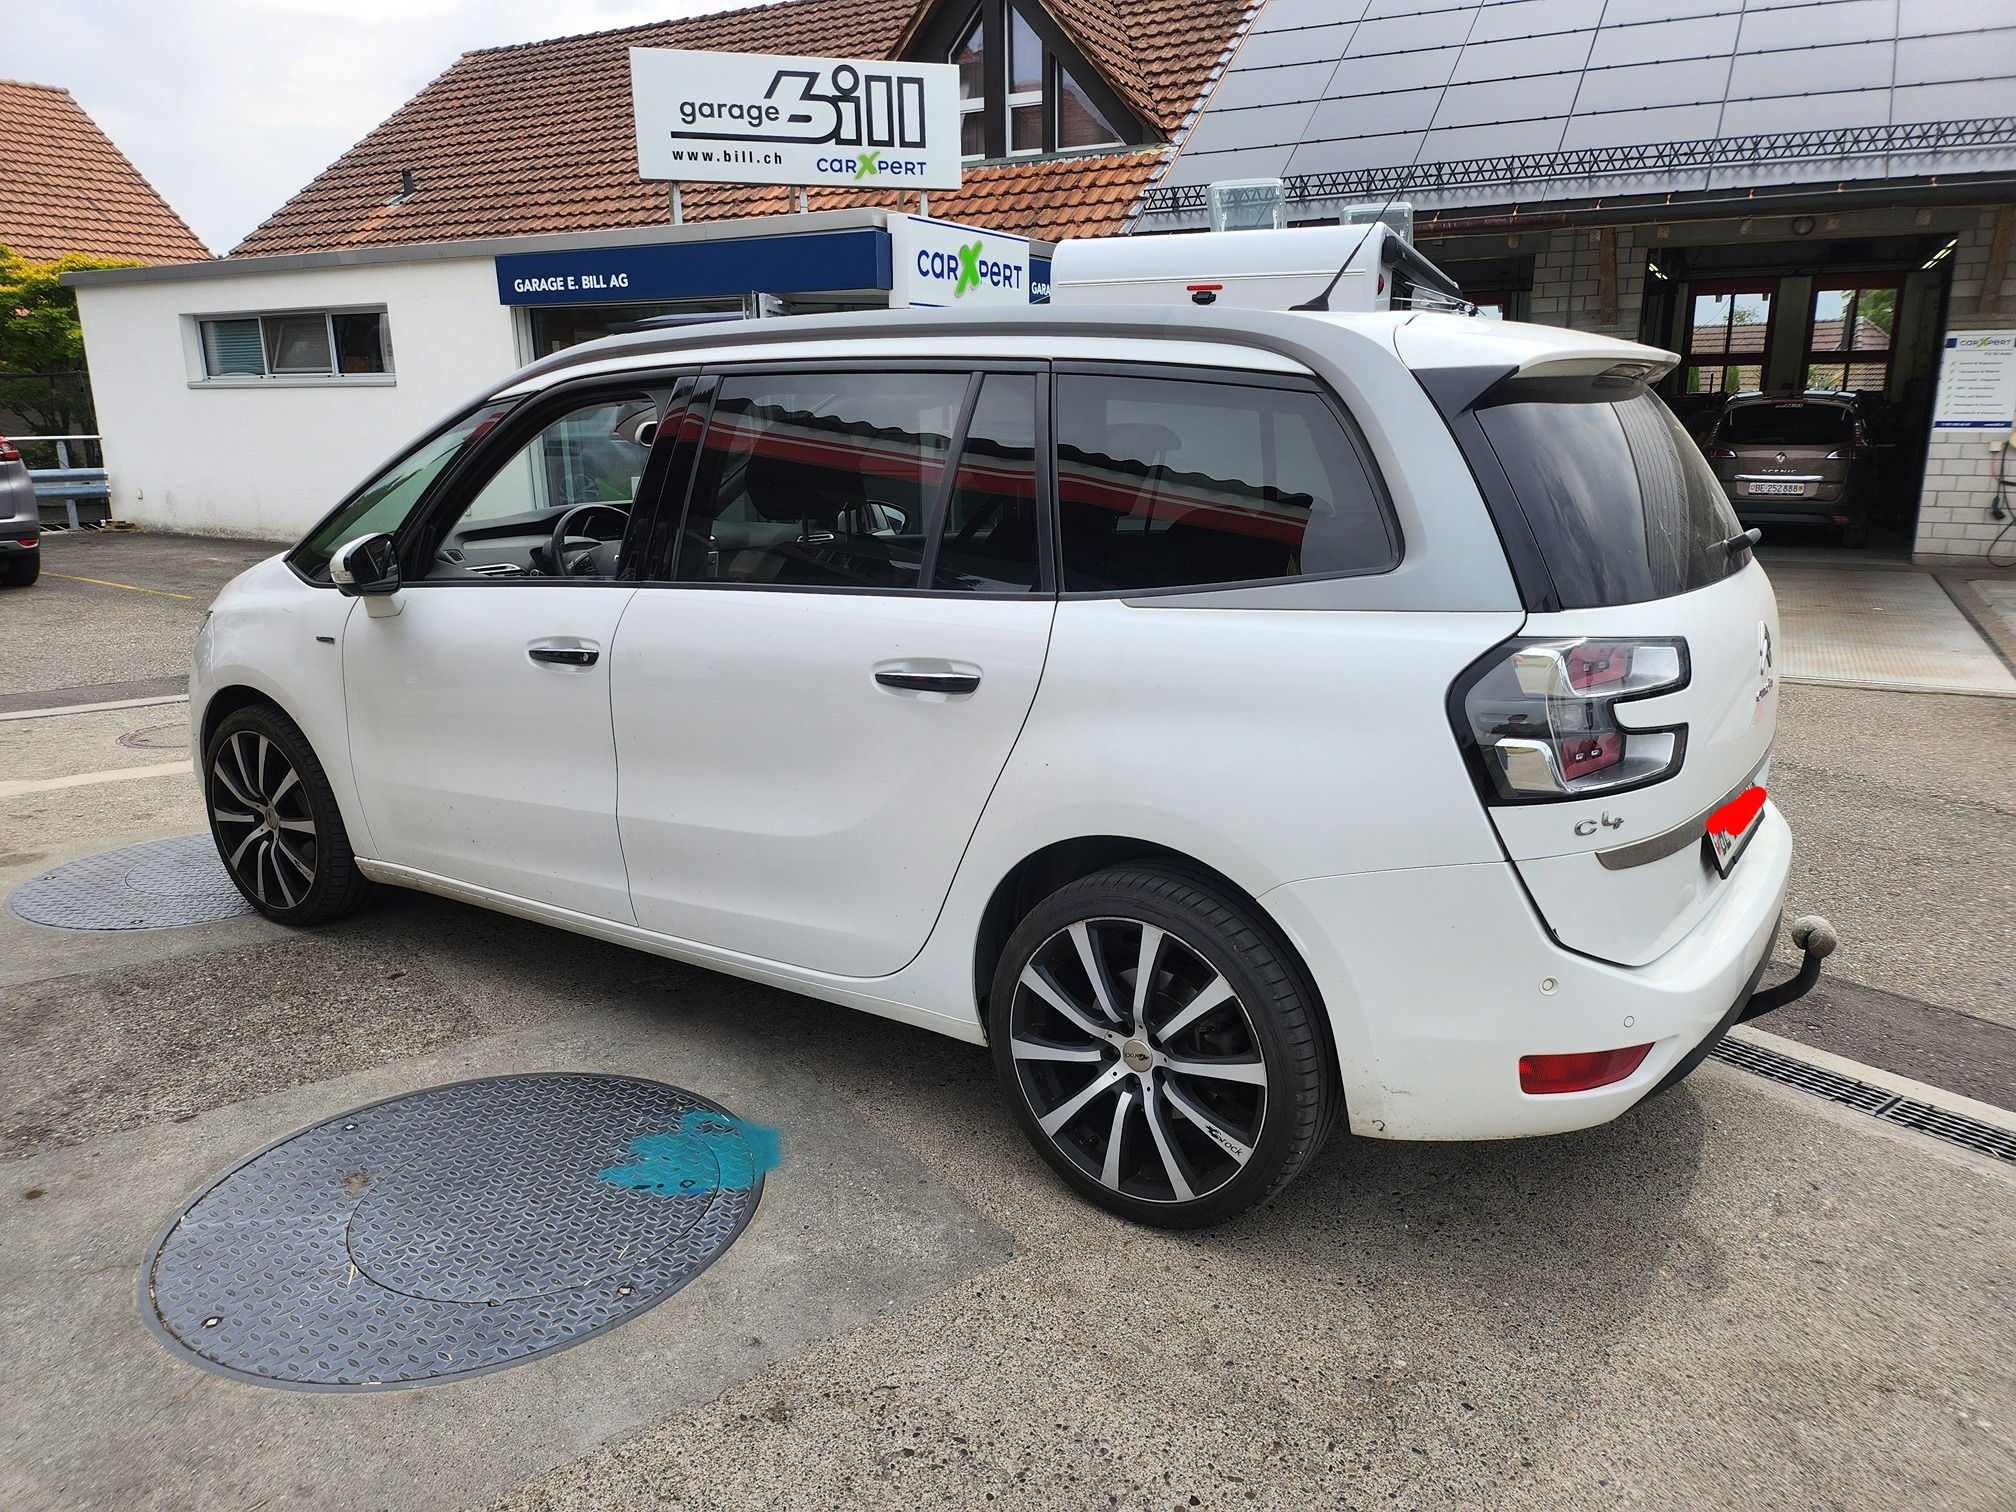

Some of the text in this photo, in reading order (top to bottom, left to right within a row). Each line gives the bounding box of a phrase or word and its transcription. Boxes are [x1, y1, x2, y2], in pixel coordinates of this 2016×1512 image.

[680, 64, 927, 149] garage Bill
[672, 149, 783, 165] www.bill.ch
[514, 273, 629, 293] GARAGE E. BILL AG
[1574, 811, 1625, 836] C4
